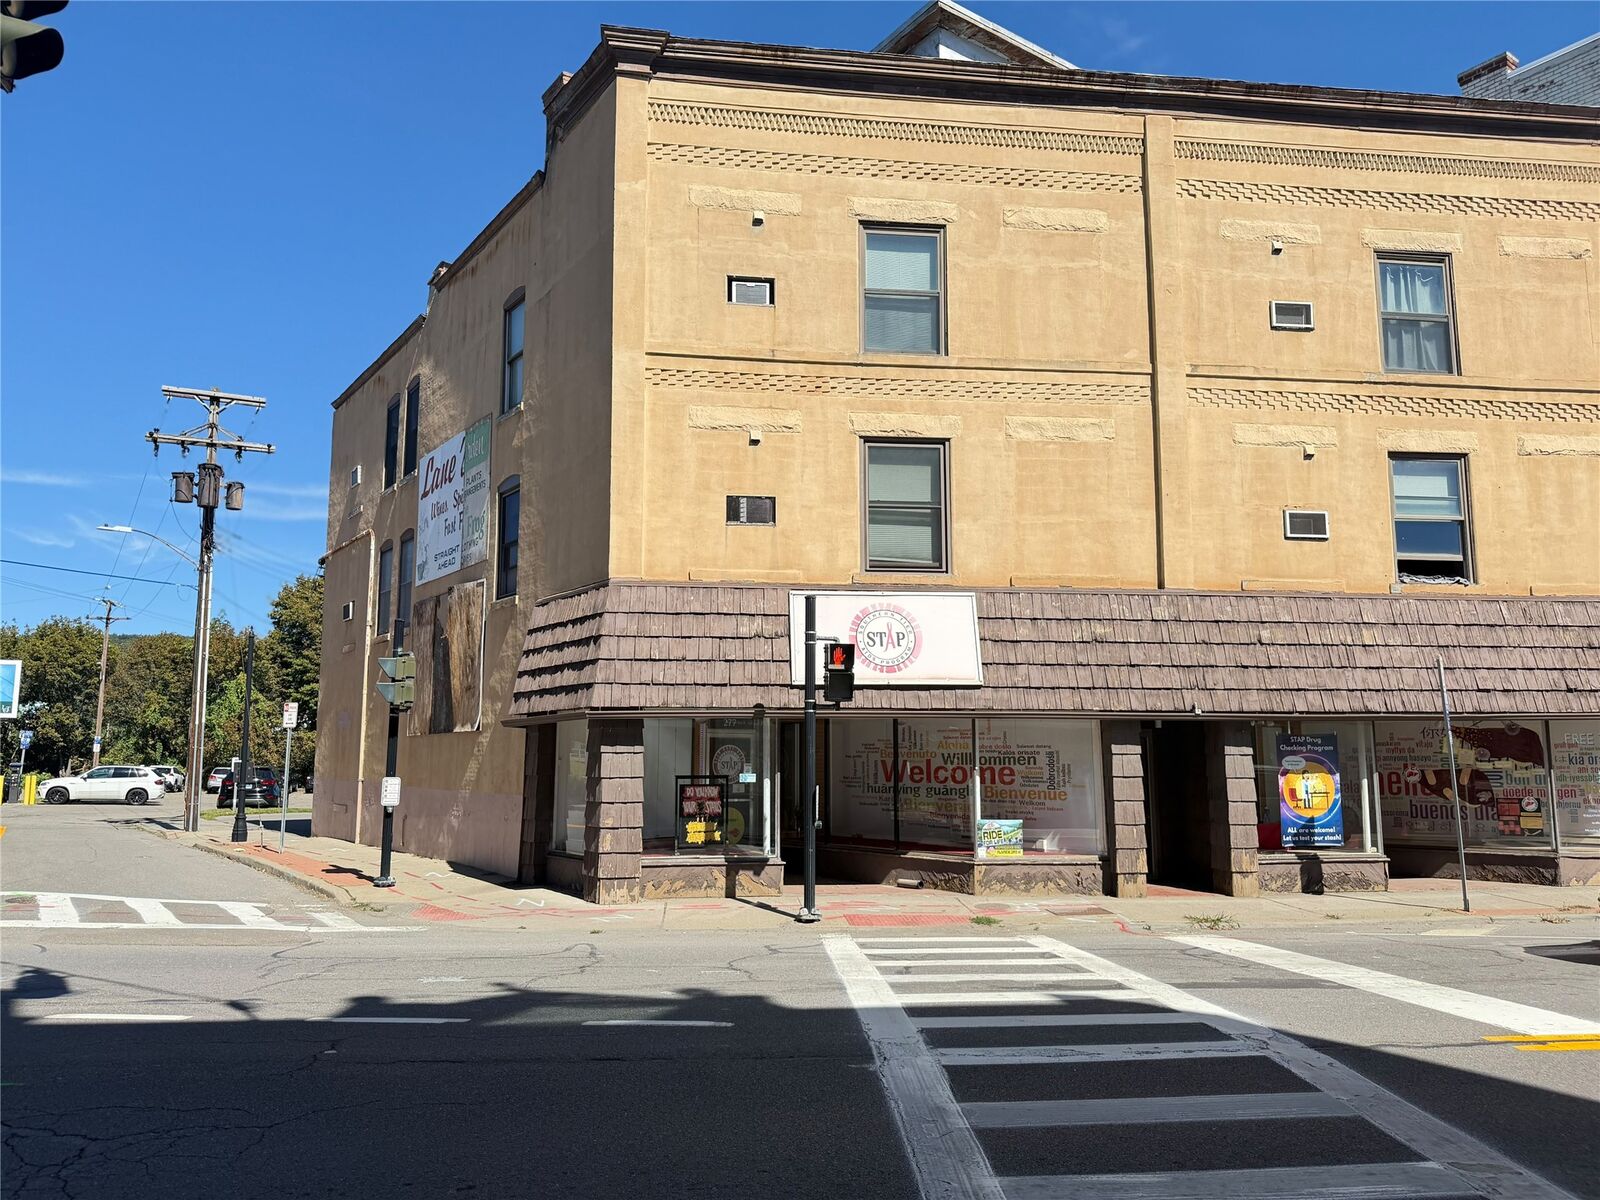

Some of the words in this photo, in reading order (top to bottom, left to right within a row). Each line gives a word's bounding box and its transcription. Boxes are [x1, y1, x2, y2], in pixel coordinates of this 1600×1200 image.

[421, 455, 457, 500] Lane
[466, 470, 482, 487] PLANTS
[434, 544, 461, 562] STRAIGHT
[437, 556, 456, 571] AHEAD
[866, 622, 906, 652] STAP
[1306, 736, 1321, 744] Drug
[1564, 733, 1594, 745] FREE
[1280, 744, 1306, 752] Checking
[720, 756, 739, 770] STAP
[1568, 753, 1585, 766] kia
[880, 759, 1016, 785] Welcome
[984, 785, 1068, 801] Bienvenue
[1537, 787, 1577, 800] mgen
[983, 830, 1002, 840] RIDE
